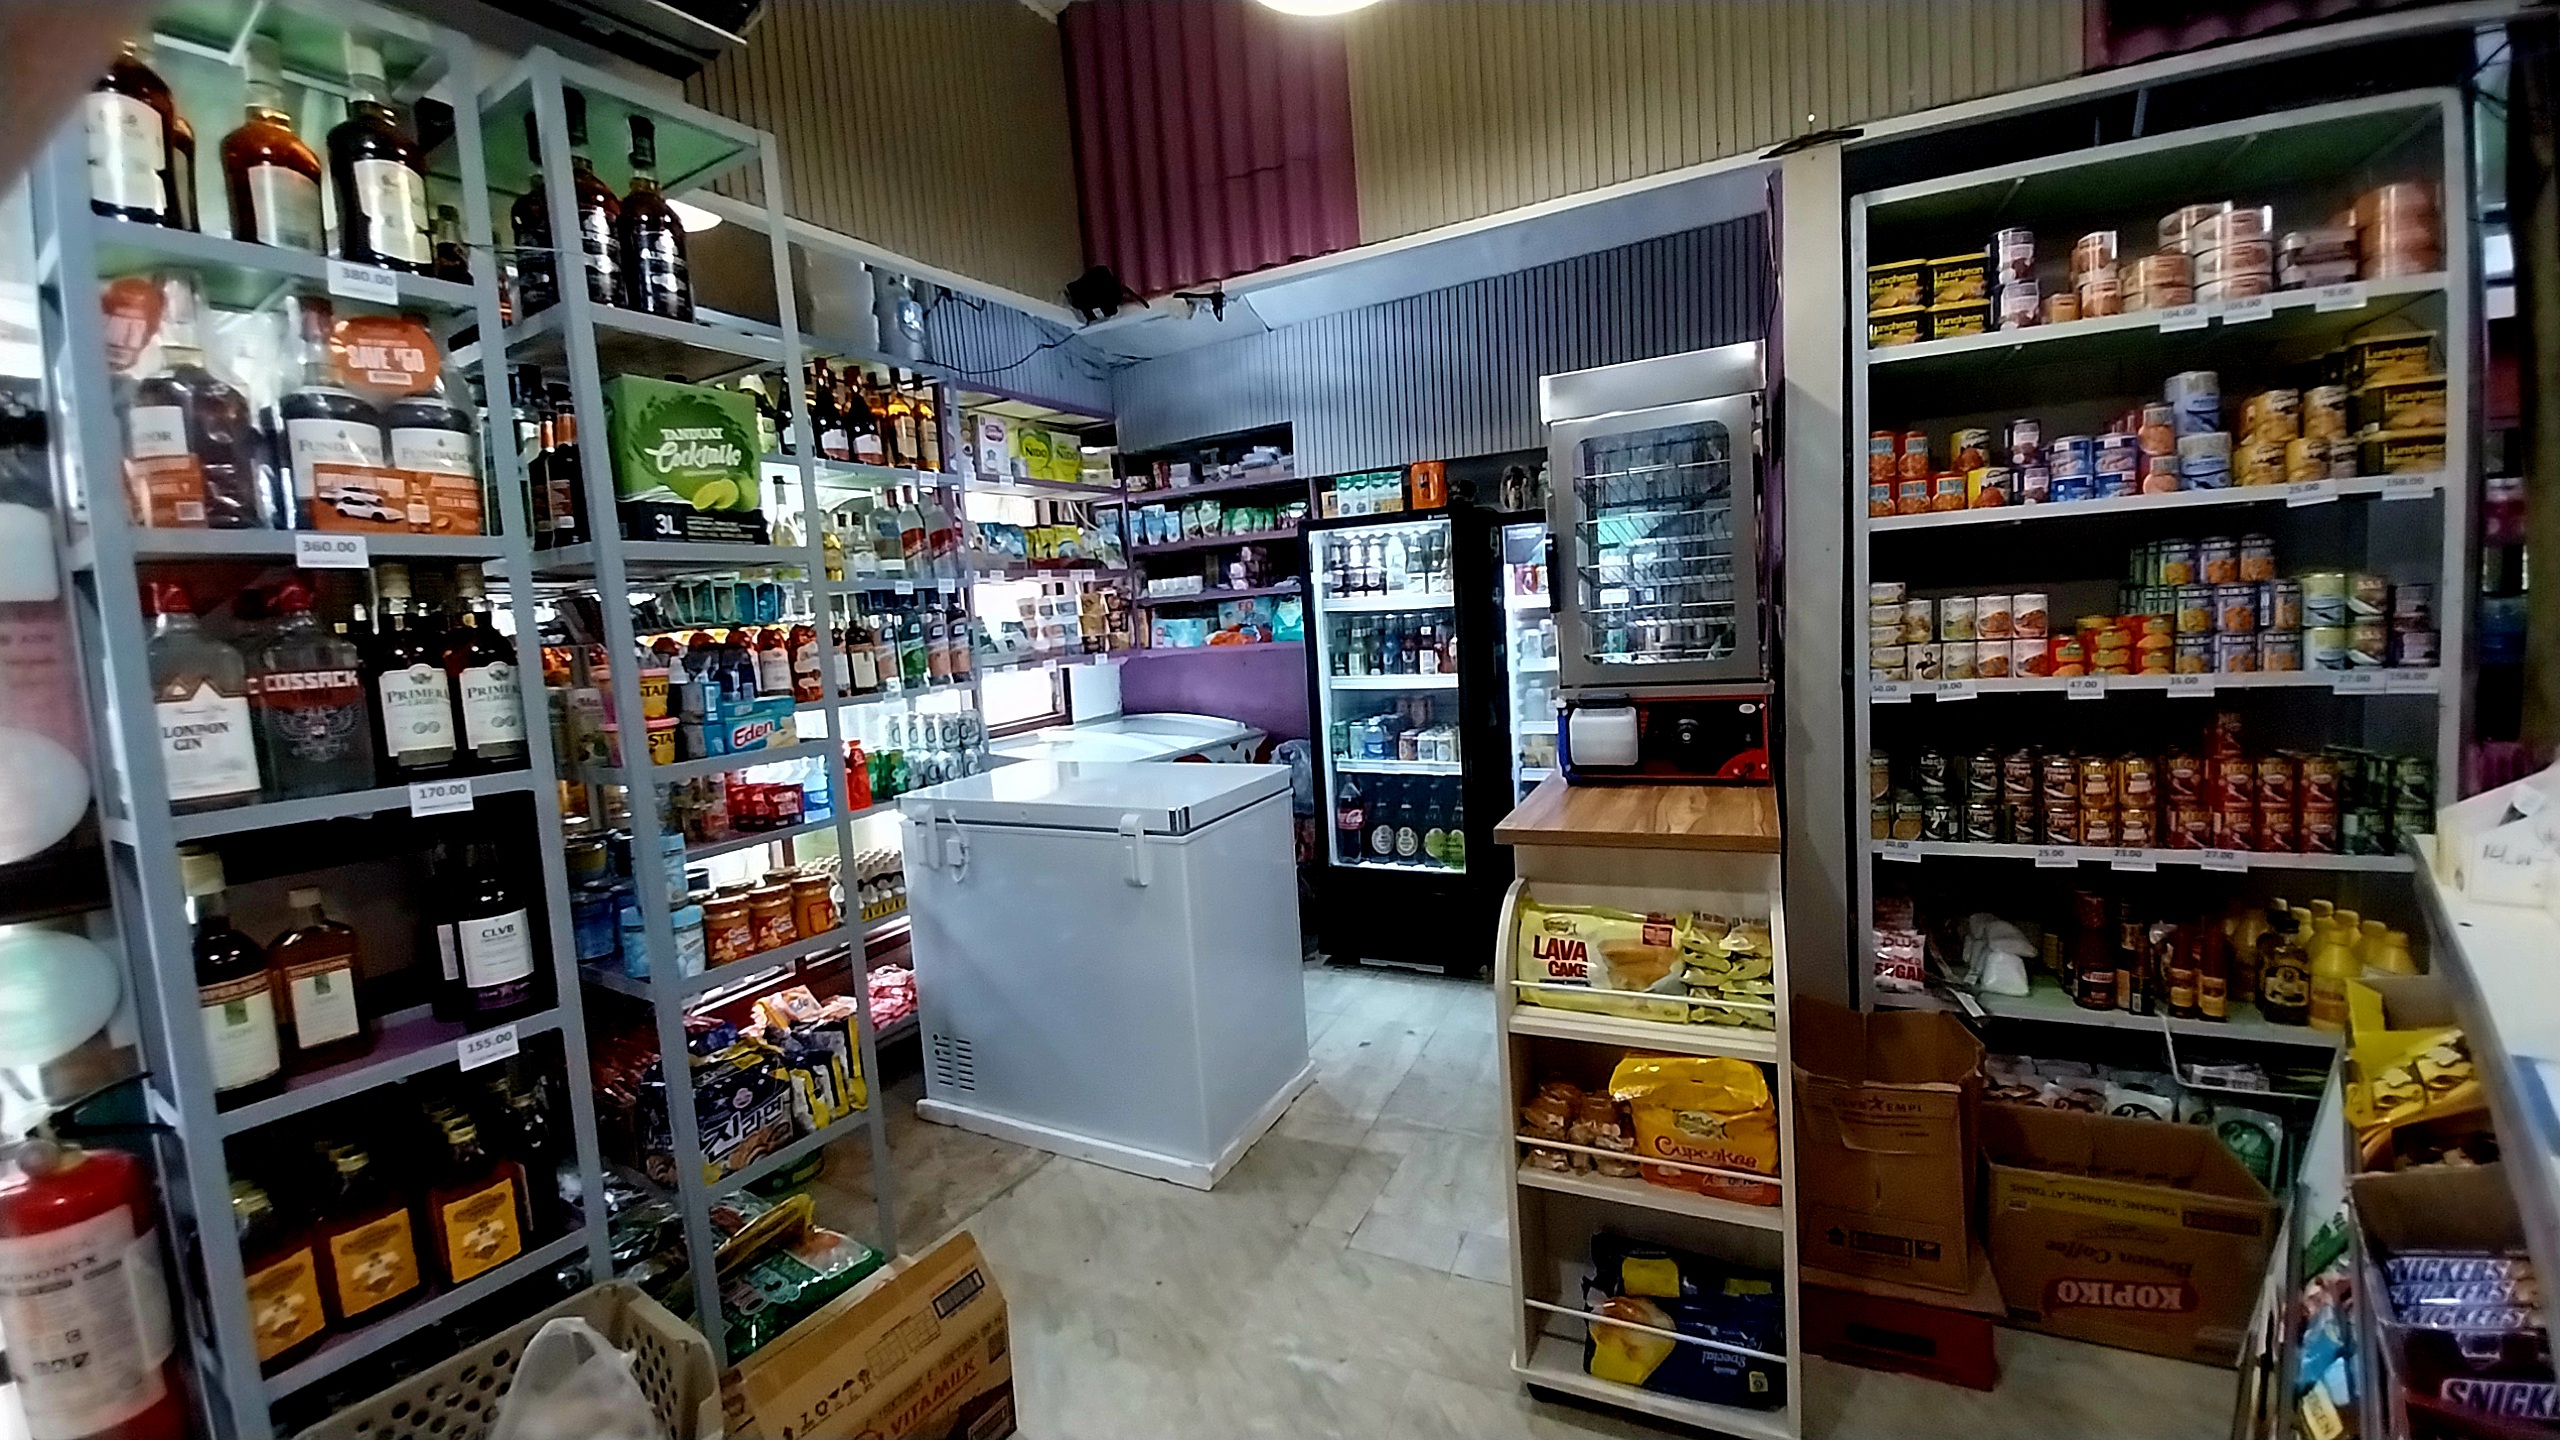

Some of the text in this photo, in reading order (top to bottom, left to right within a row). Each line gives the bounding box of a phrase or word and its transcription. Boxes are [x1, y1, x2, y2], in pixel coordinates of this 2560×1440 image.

[342, 267, 393, 287] 380.00
[1934, 266, 1983, 283] Luncheon
[1934, 313, 1983, 330] Luncheon
[644, 441, 742, 473] Cocktails
[654, 514, 682, 535] 3L
[303, 541, 356, 553] 360.00
[264, 670, 359, 692] COSSACK
[162, 722, 229, 738] LONDON
[734, 721, 774, 748] Eden
[174, 738, 202, 751] GIN
[1937, 765, 1945, 777] 7
[420, 784, 467, 799] 170.00
[1533, 935, 1588, 963] LAVA
[1548, 960, 1588, 979] CAKE
[468, 1032, 513, 1053] 155.00
[1653, 1135, 1758, 1169] Cupcakes
[2045, 1240, 2111, 1264] Coffee
[2057, 1280, 2183, 1310] KOPIKO
[1702, 1351, 1746, 1368] Special
[890, 1361, 976, 1435] VITAMILK
